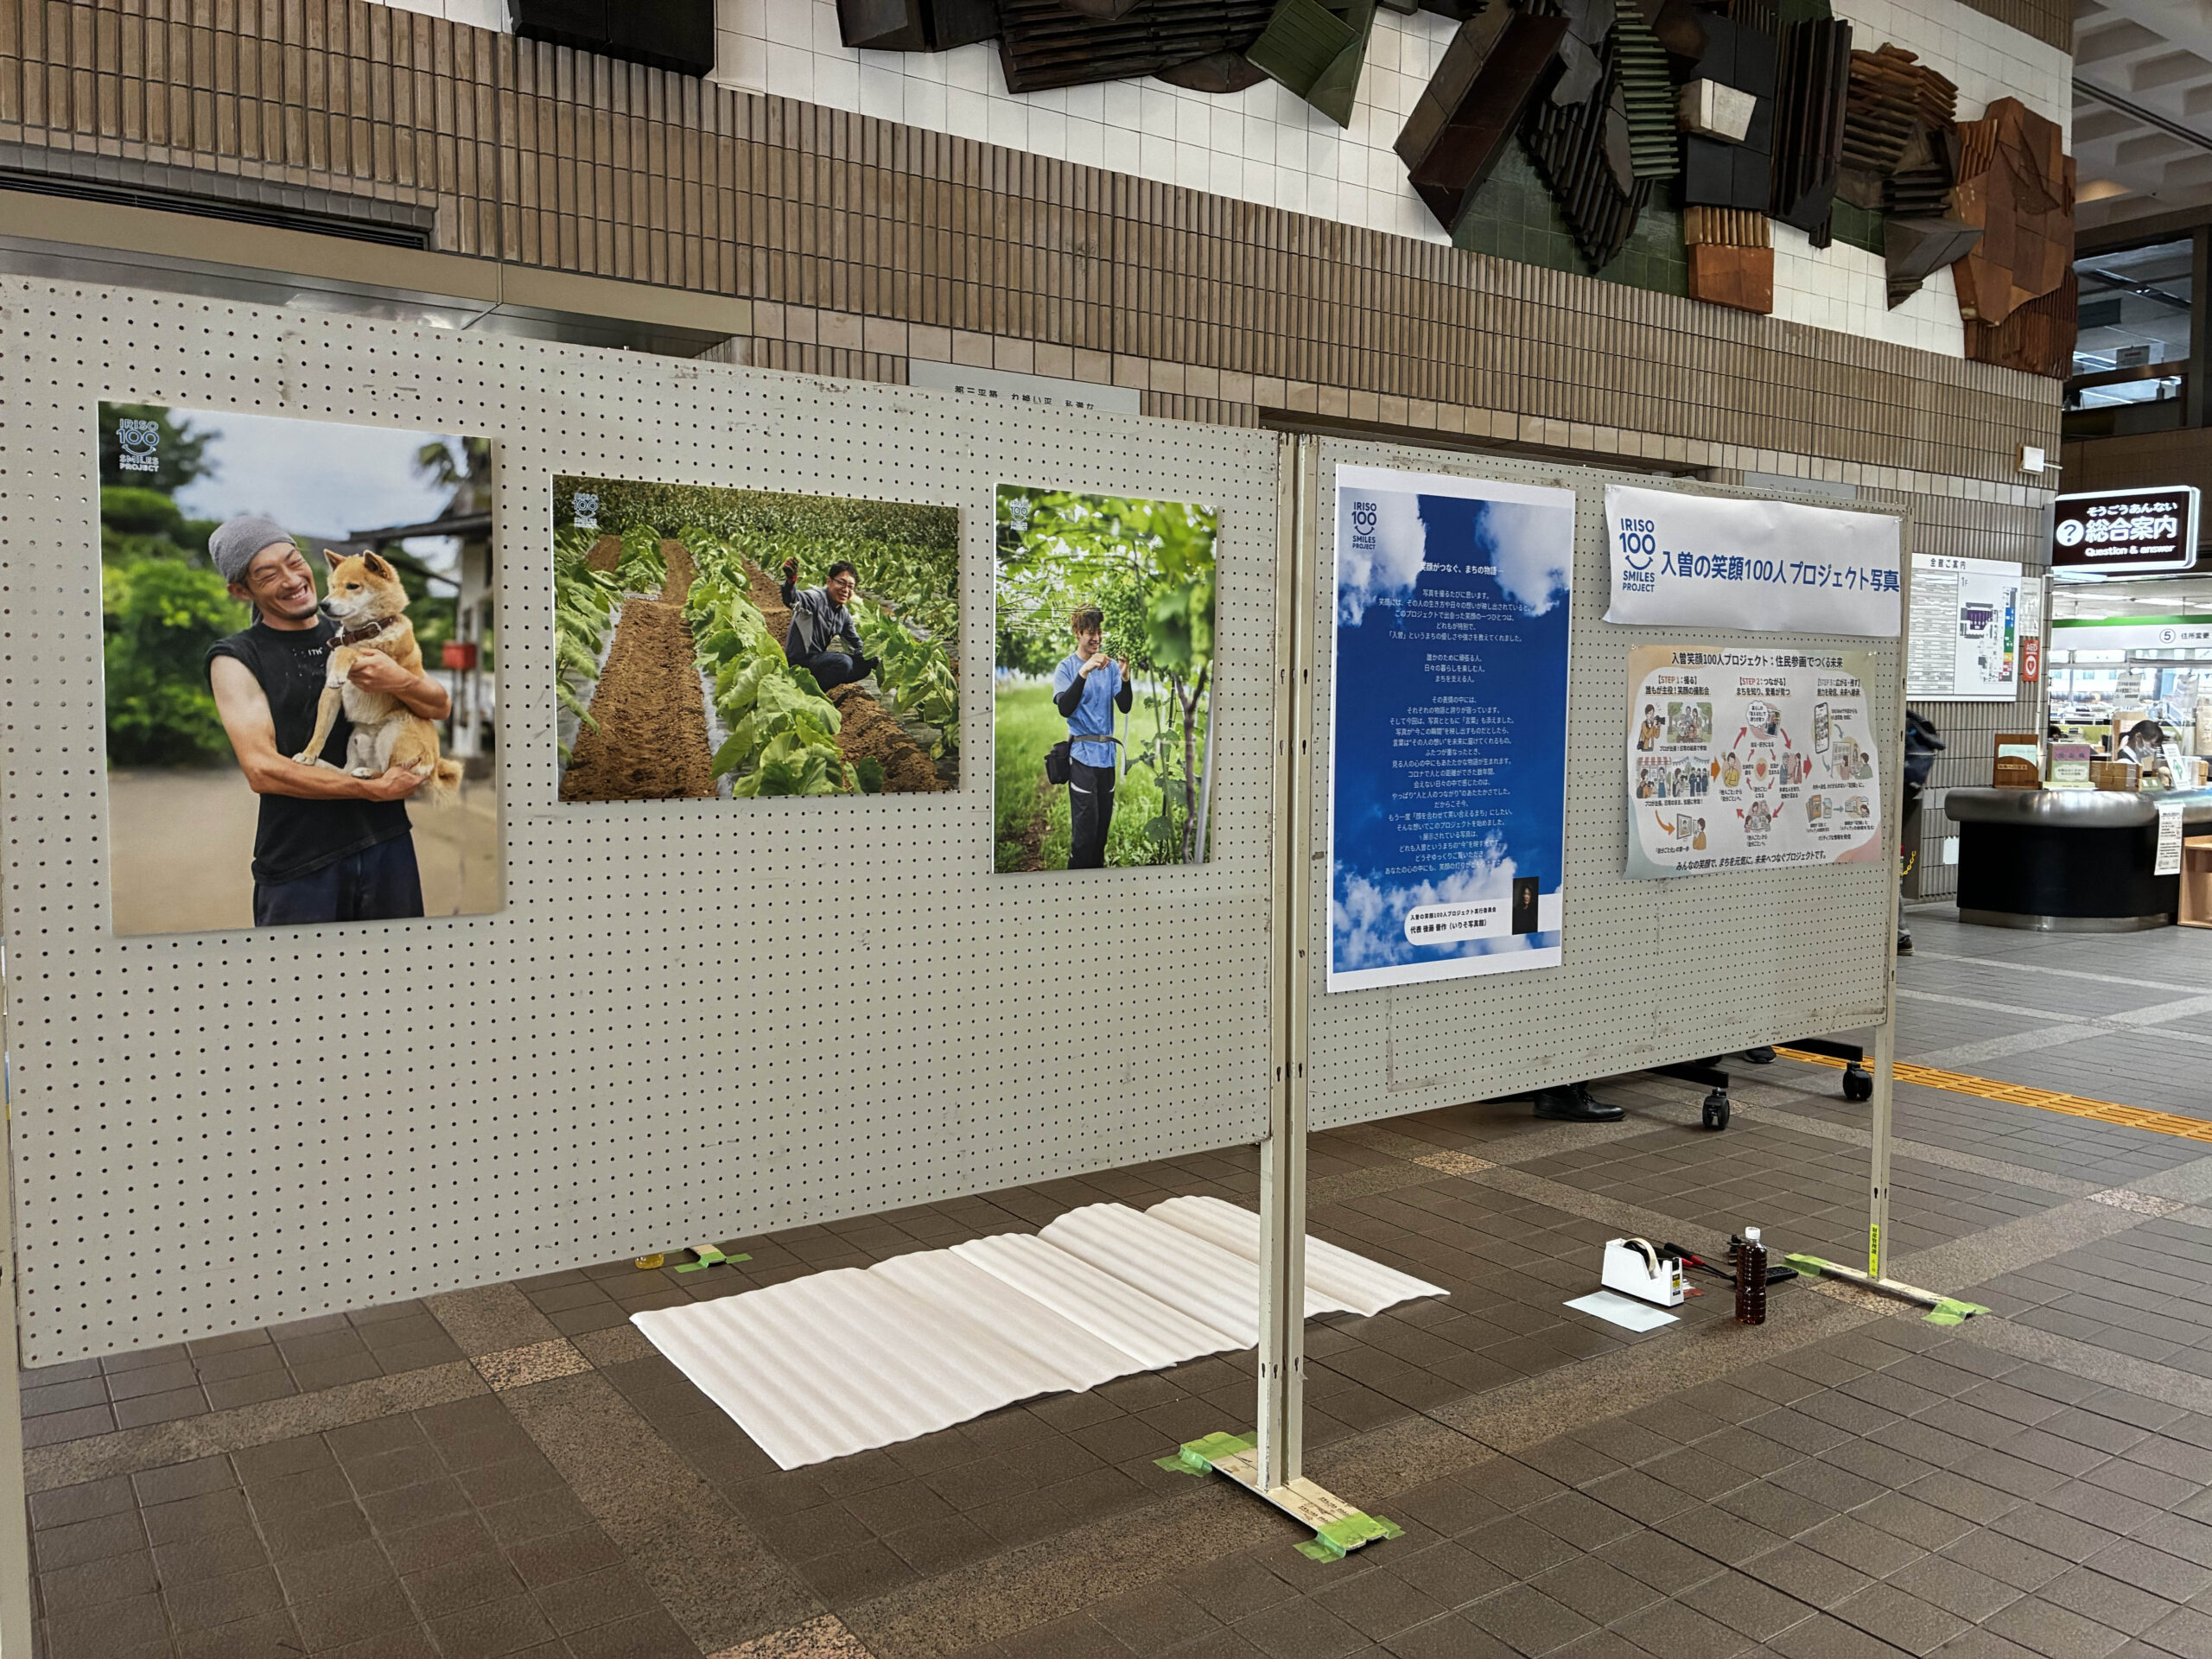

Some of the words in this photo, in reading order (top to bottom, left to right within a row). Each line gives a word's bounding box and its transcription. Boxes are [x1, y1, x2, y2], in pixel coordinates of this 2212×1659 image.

[119, 418, 159, 431] IRISO
[116, 429, 160, 446] 100
[119, 454, 159, 465] SMILES
[119, 462, 159, 472] PROJECT
[571, 499, 599, 511] 100
[1010, 506, 1028, 516] 100
[1353, 501, 1377, 512] IRISO
[2087, 502, 2177, 517] そうごうあんない
[1351, 512, 1377, 526] 100
[1620, 518, 1655, 533] IRISO
[2084, 514, 2177, 543] 総合案内
[1619, 532, 1656, 555] 100
[2084, 545, 2128, 556] Question
[2129, 545, 2139, 555] &
[1623, 570, 1656, 583] SMILES
[1661, 550, 1900, 593] 入曽の笑顔100人プロジェクト写真
[1622, 582, 1656, 593] PROJECT
